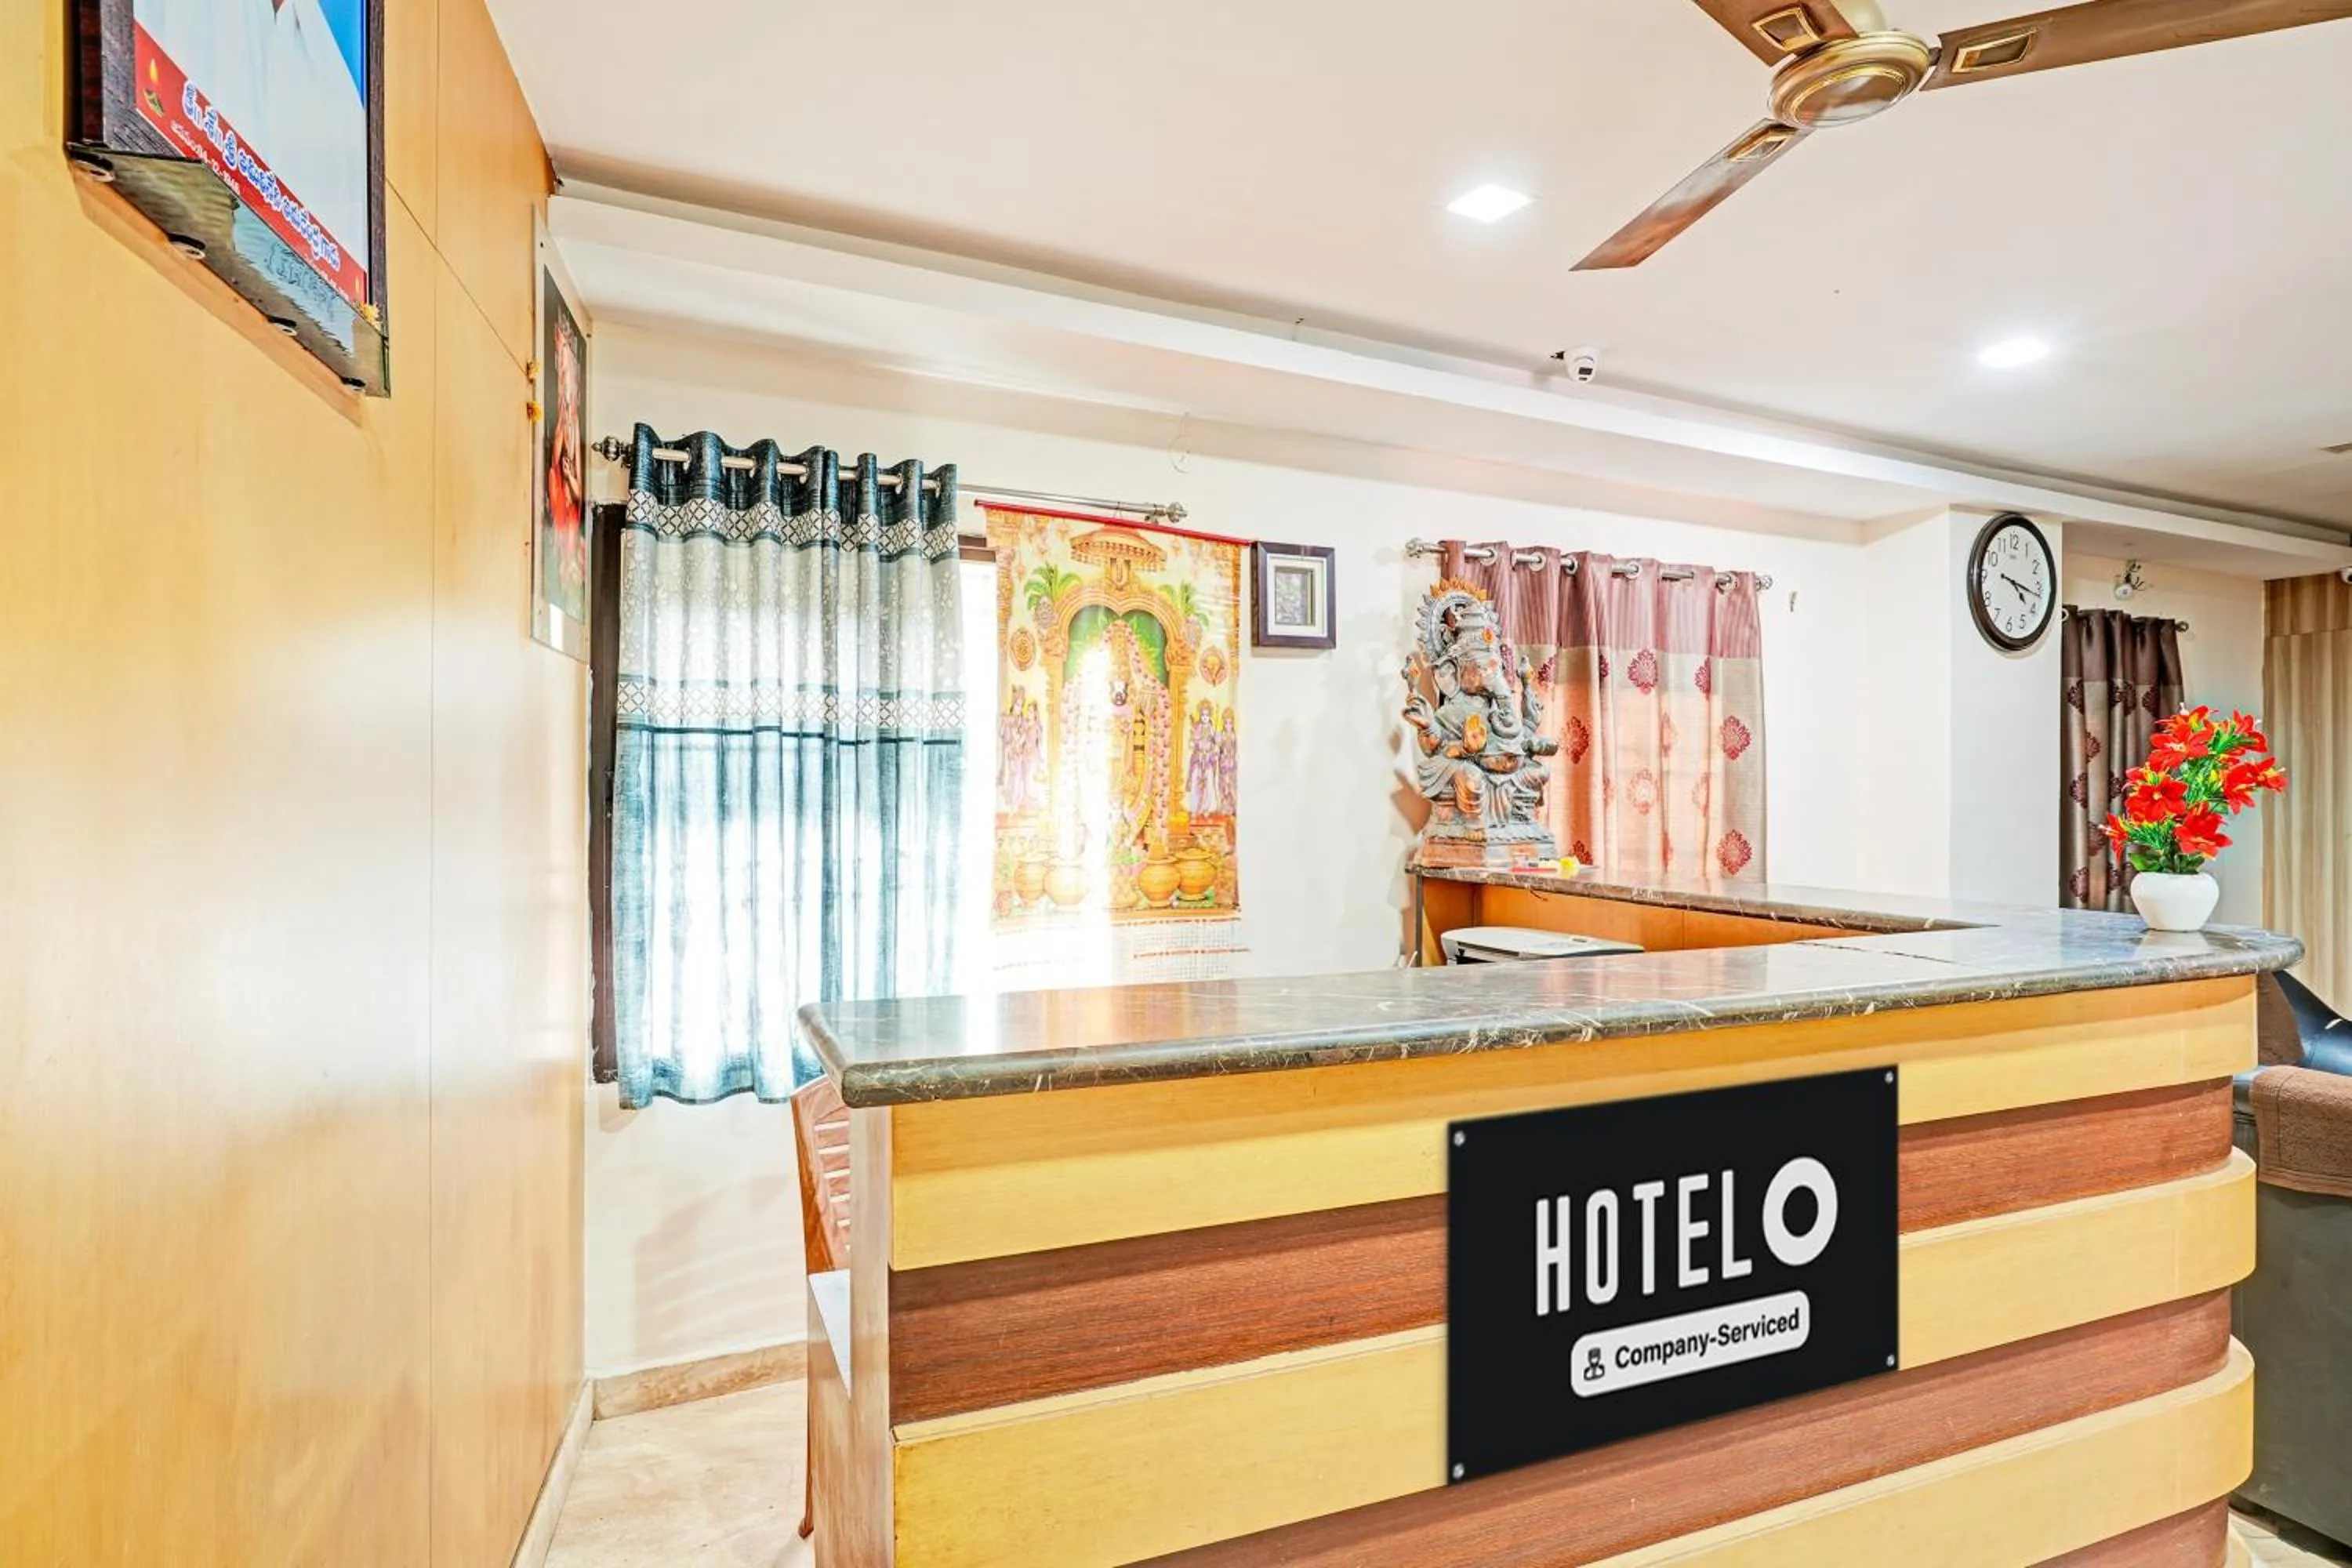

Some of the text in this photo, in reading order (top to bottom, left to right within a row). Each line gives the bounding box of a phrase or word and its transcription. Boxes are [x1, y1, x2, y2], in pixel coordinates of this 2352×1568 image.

[1998, 538, 2005, 554] 11
[2009, 533, 2019, 550] 12
[1987, 550, 1998, 567] 10
[2032, 559, 2040, 574] 2
[1984, 591, 1991, 607] 8
[1994, 608, 2001, 621] 7
[2030, 602, 2036, 614] 4
[2005, 616, 2012, 632] 6
[2020, 614, 2026, 629] 5
[1536, 1169, 1752, 1316] HOTEL
[1614, 1308, 1800, 1370] Company-Serviced
